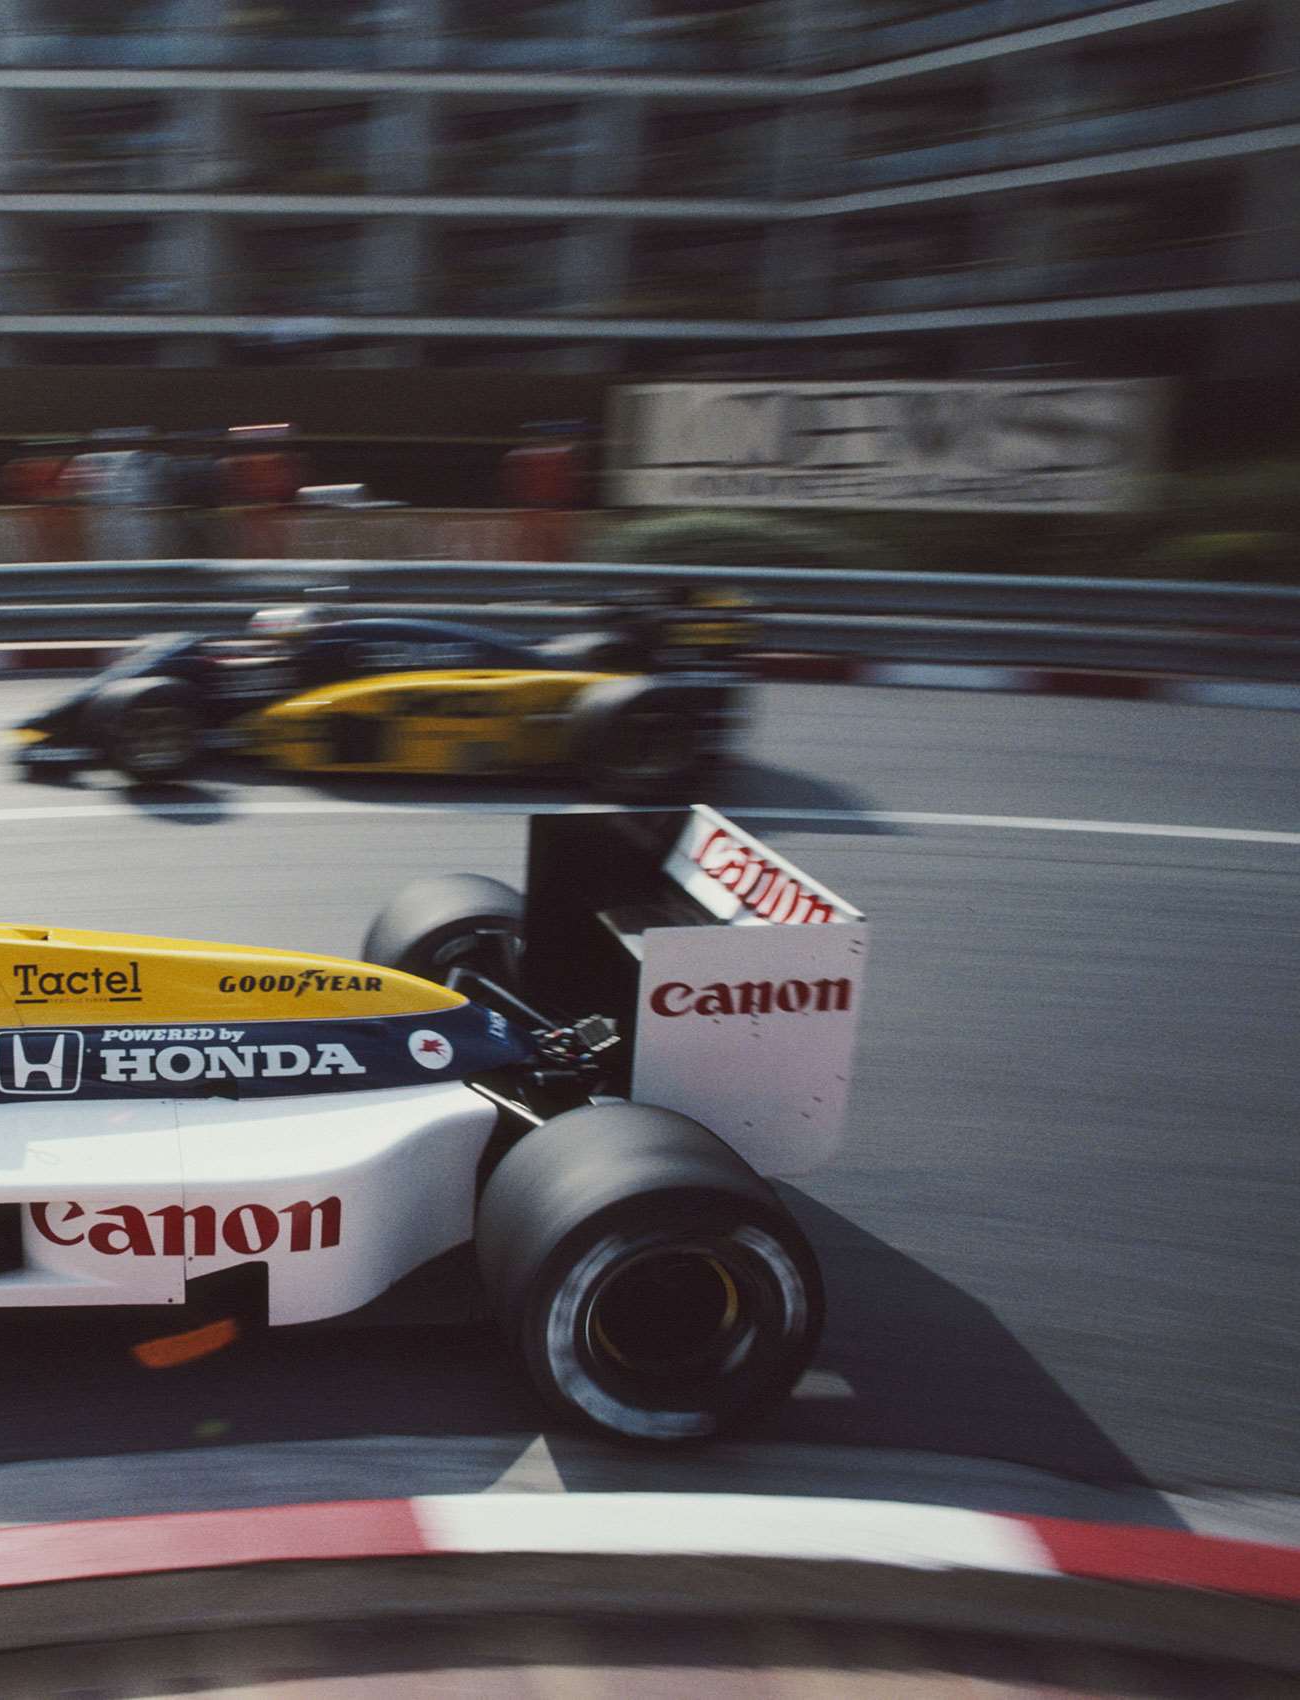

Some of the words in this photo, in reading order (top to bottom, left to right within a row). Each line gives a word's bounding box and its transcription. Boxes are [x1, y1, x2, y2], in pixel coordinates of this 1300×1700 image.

[13, 962, 142, 996] Tactel
[219, 970, 383, 997] GOODYEAR
[650, 977, 852, 1017] Canon
[101, 1028, 215, 1042] POWERED
[218, 1028, 245, 1042] by
[100, 1043, 367, 1082] HONDA
[29, 1196, 342, 1256] Canon
